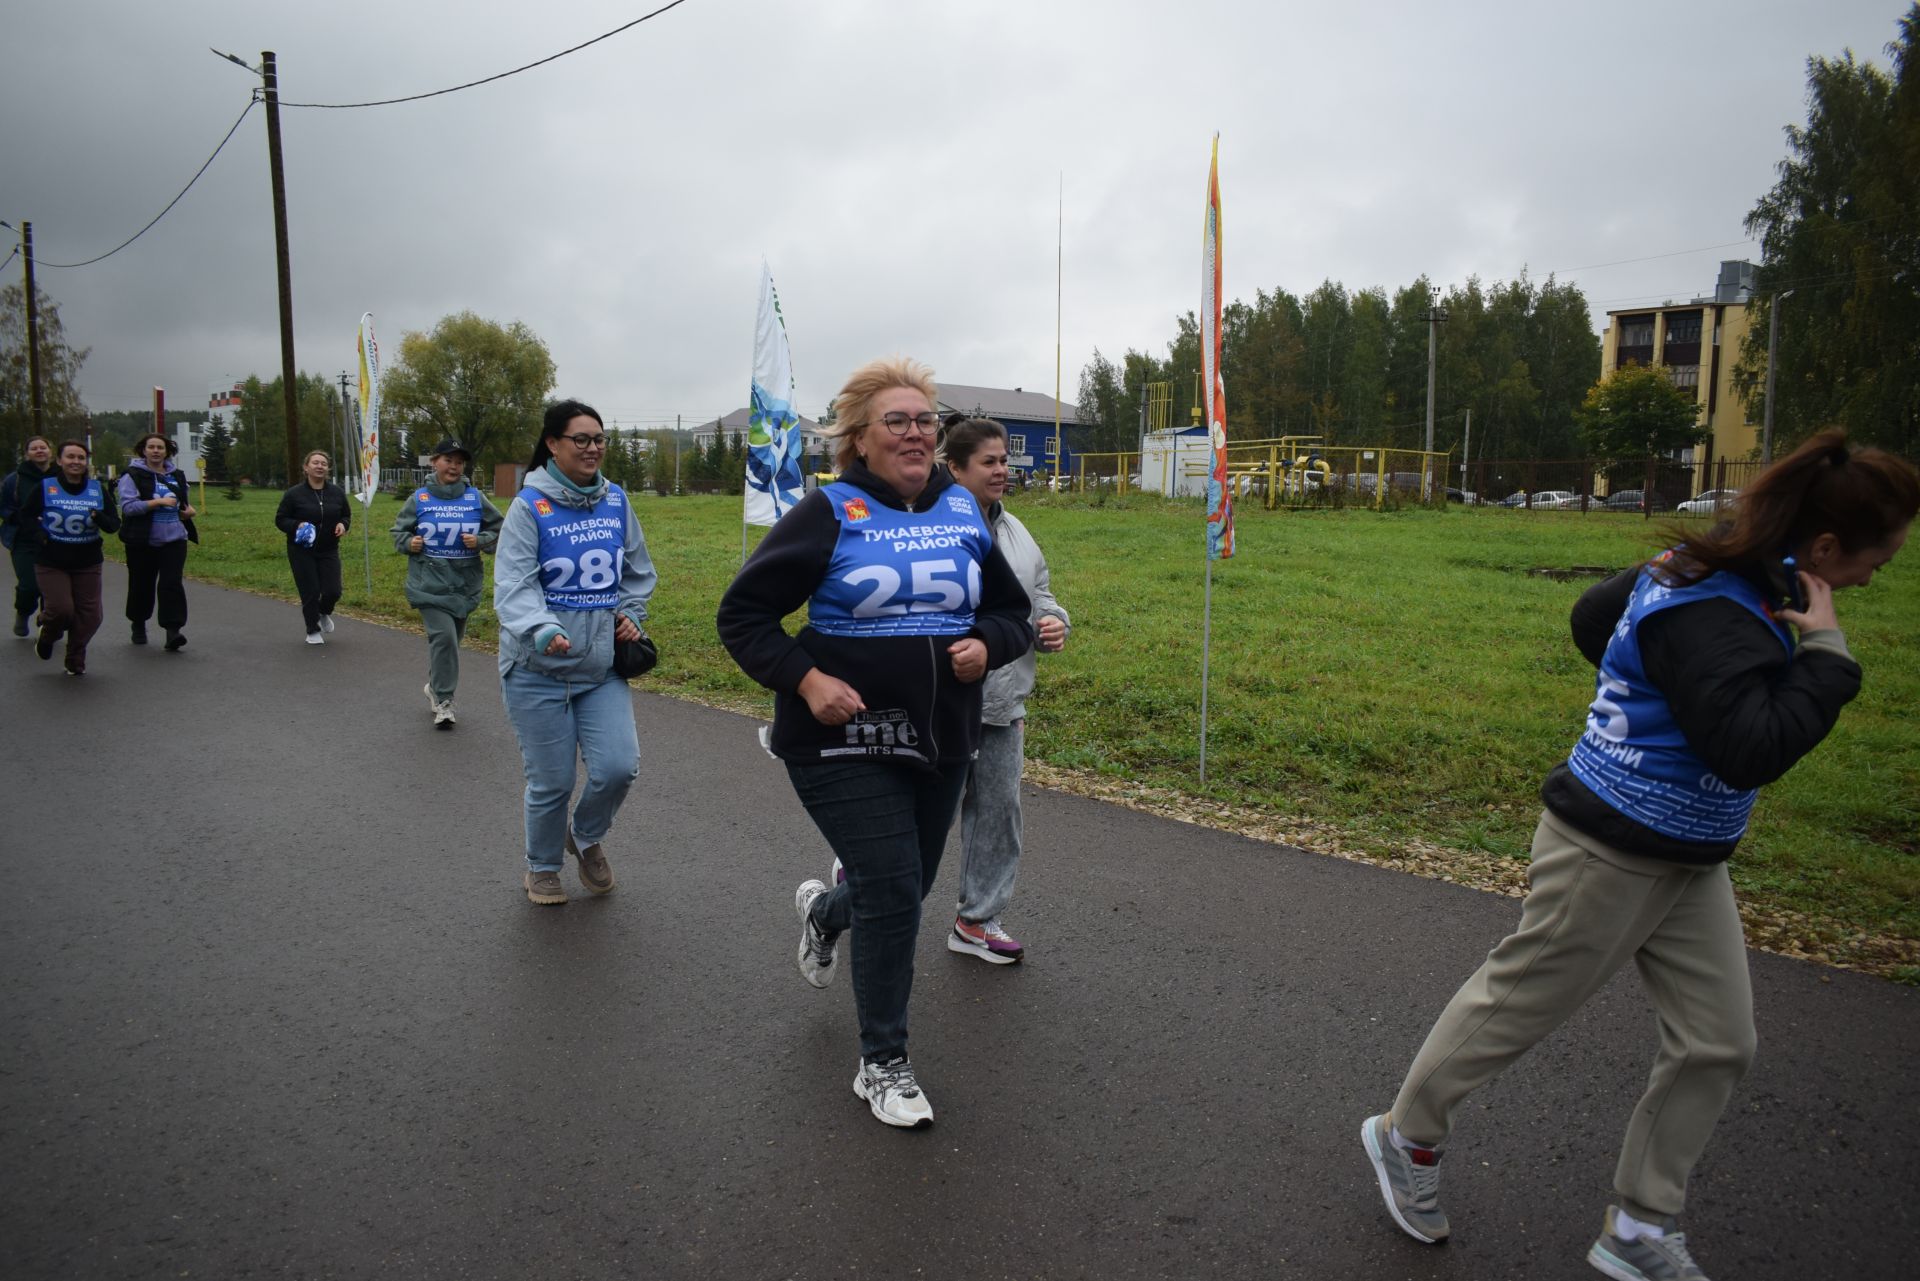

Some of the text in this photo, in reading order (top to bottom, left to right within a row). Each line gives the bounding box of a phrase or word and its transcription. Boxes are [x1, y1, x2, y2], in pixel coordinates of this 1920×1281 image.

[52, 499, 98, 507] ТУКАЕВСКИЙ
[548, 517, 622, 537] ТУКАЕВСКИЙ
[862, 524, 980, 542] ТУКАЕВСКИЙ
[570, 529, 613, 545] РАЙОН
[893, 535, 962, 553] РАЙОН
[846, 722, 919, 746] me
[868, 746, 891, 755] IT'S
